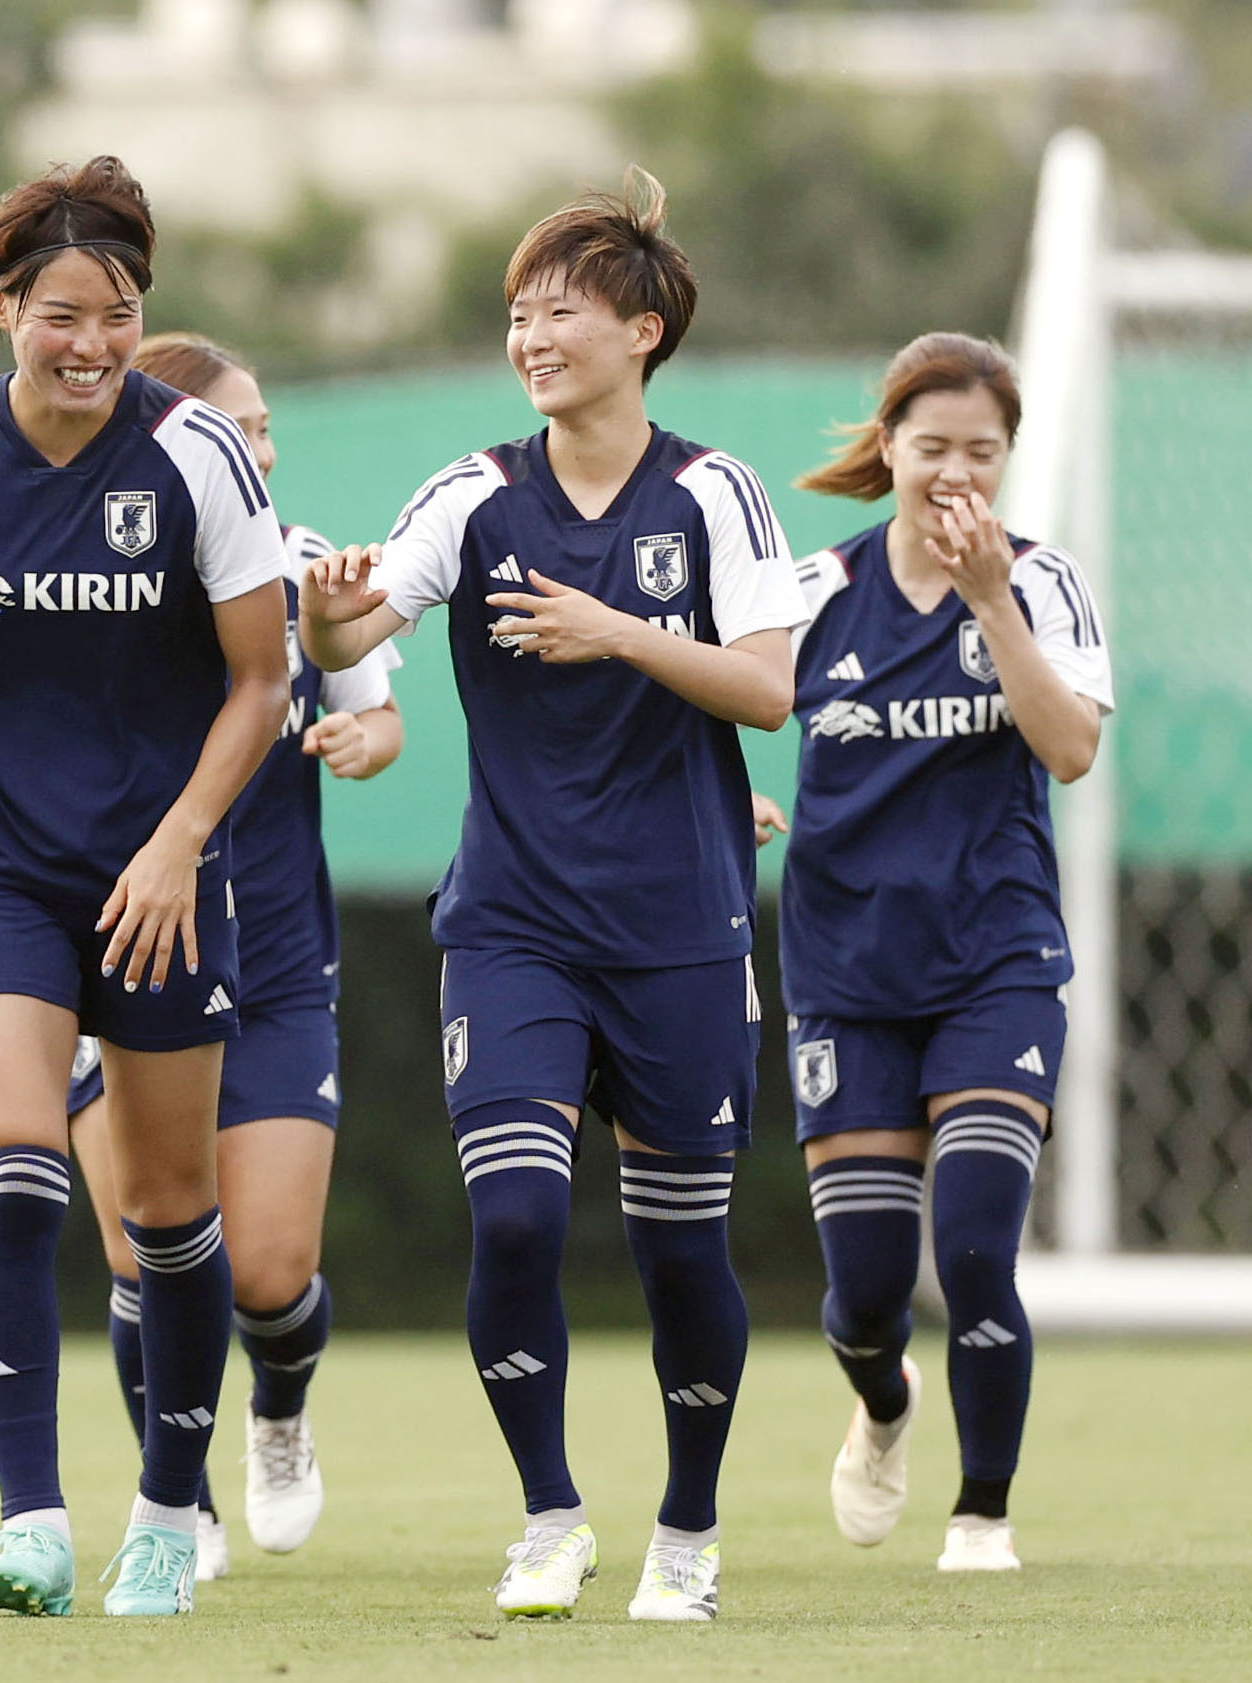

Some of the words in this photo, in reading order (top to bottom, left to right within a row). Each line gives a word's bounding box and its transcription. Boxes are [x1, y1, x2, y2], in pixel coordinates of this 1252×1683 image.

[120, 536, 142, 545] JFA
[647, 537, 673, 545] JAPAN
[652, 578, 674, 588] JFA
[23, 571, 165, 612] KIRIN
